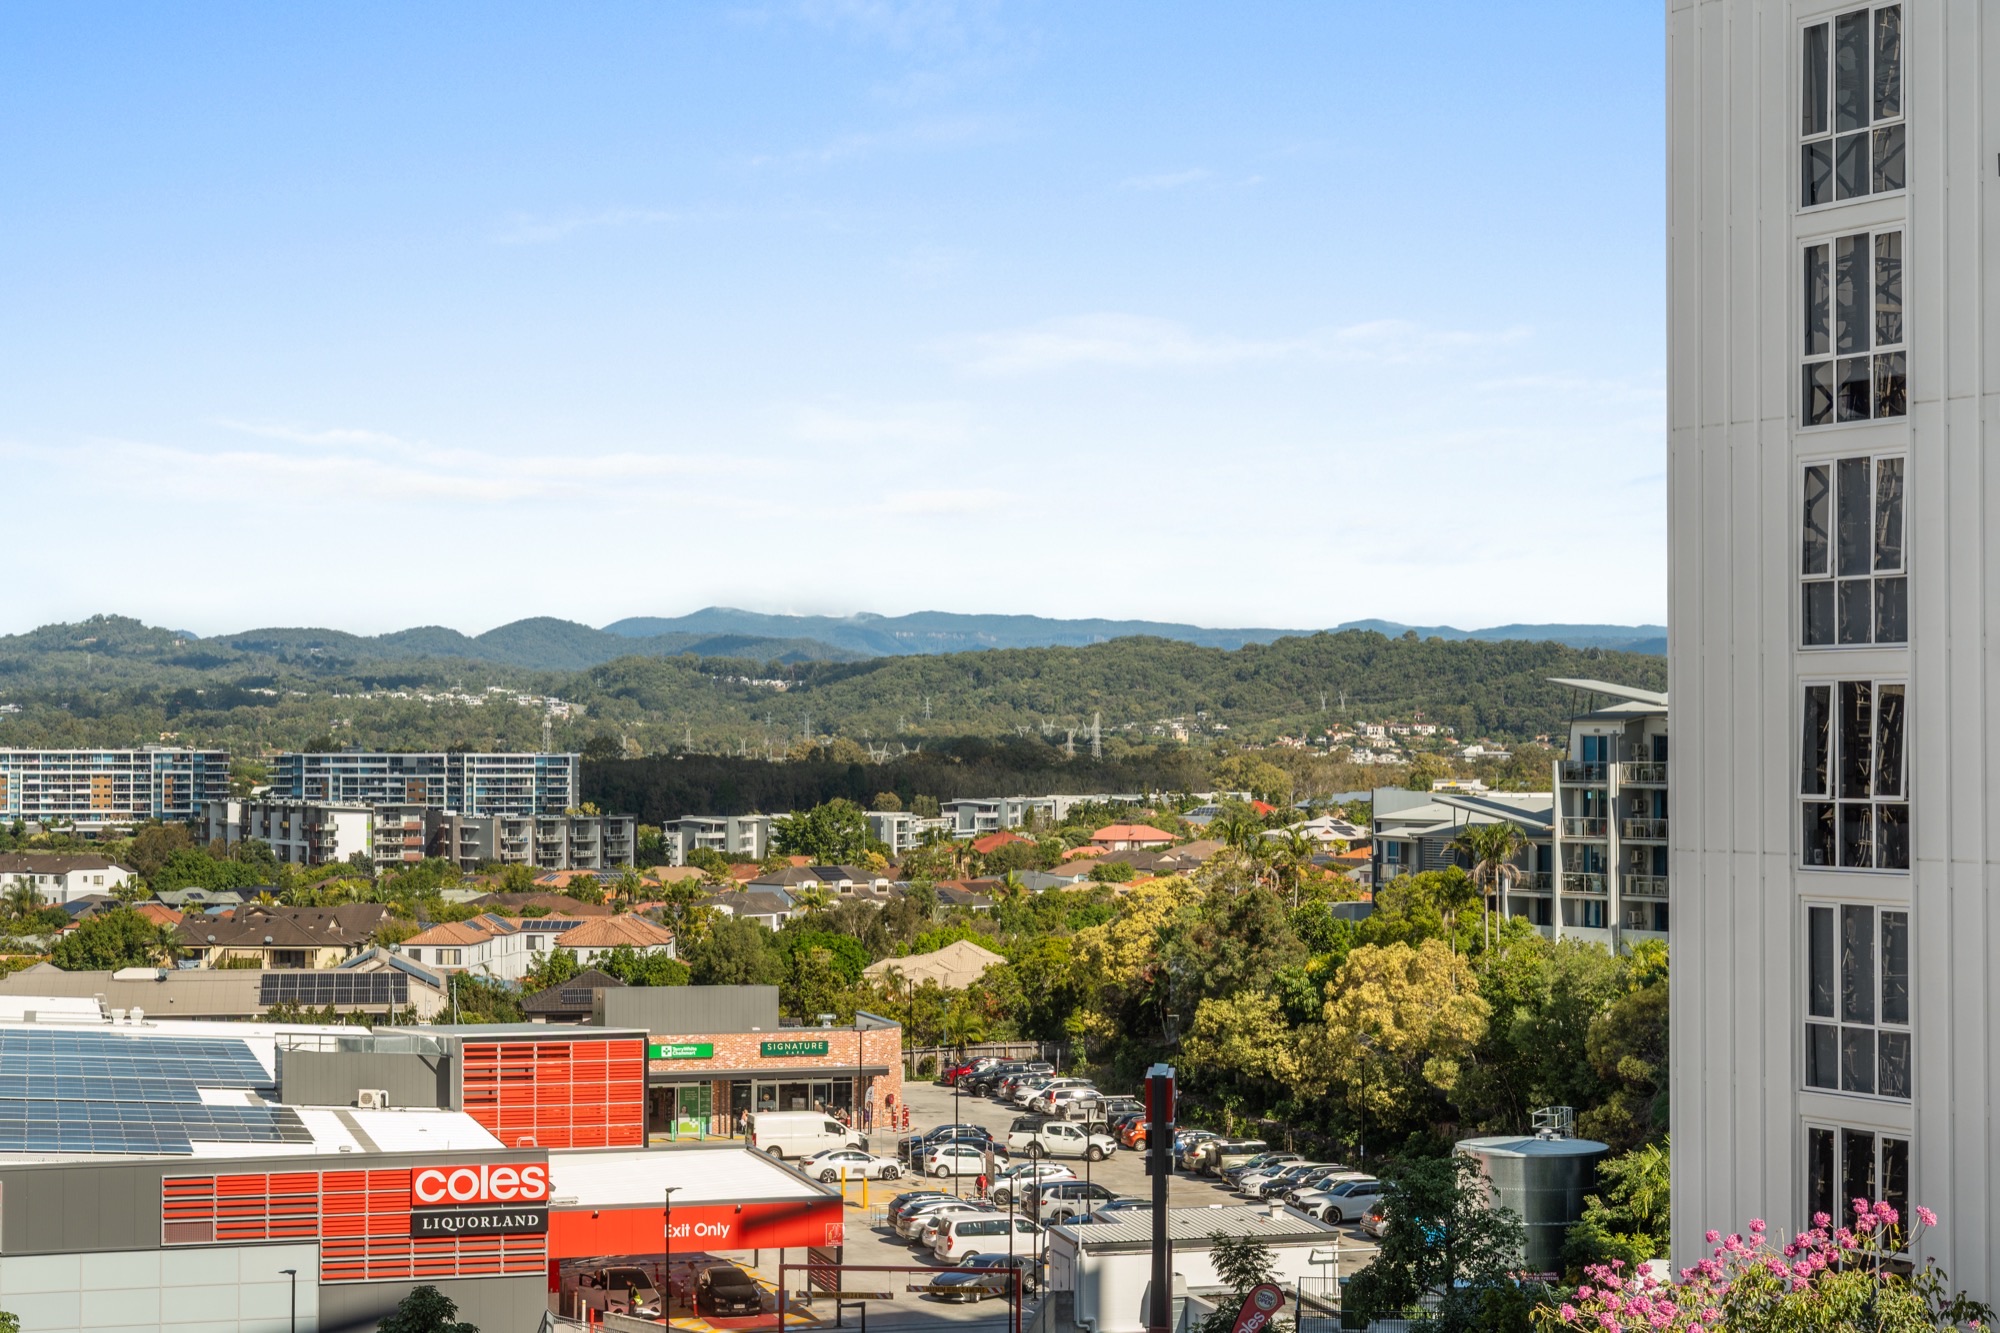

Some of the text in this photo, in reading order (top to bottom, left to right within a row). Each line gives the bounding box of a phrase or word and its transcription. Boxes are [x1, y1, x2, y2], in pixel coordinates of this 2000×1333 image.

[767, 1042, 823, 1050] SIGNATURE
[415, 1165, 546, 1202] coles
[422, 1214, 539, 1232] LIQUORLAND
[664, 1222, 730, 1239] Exit Only
[1257, 1296, 1273, 1306] OPEN
[1260, 1292, 1273, 1301] NOW
